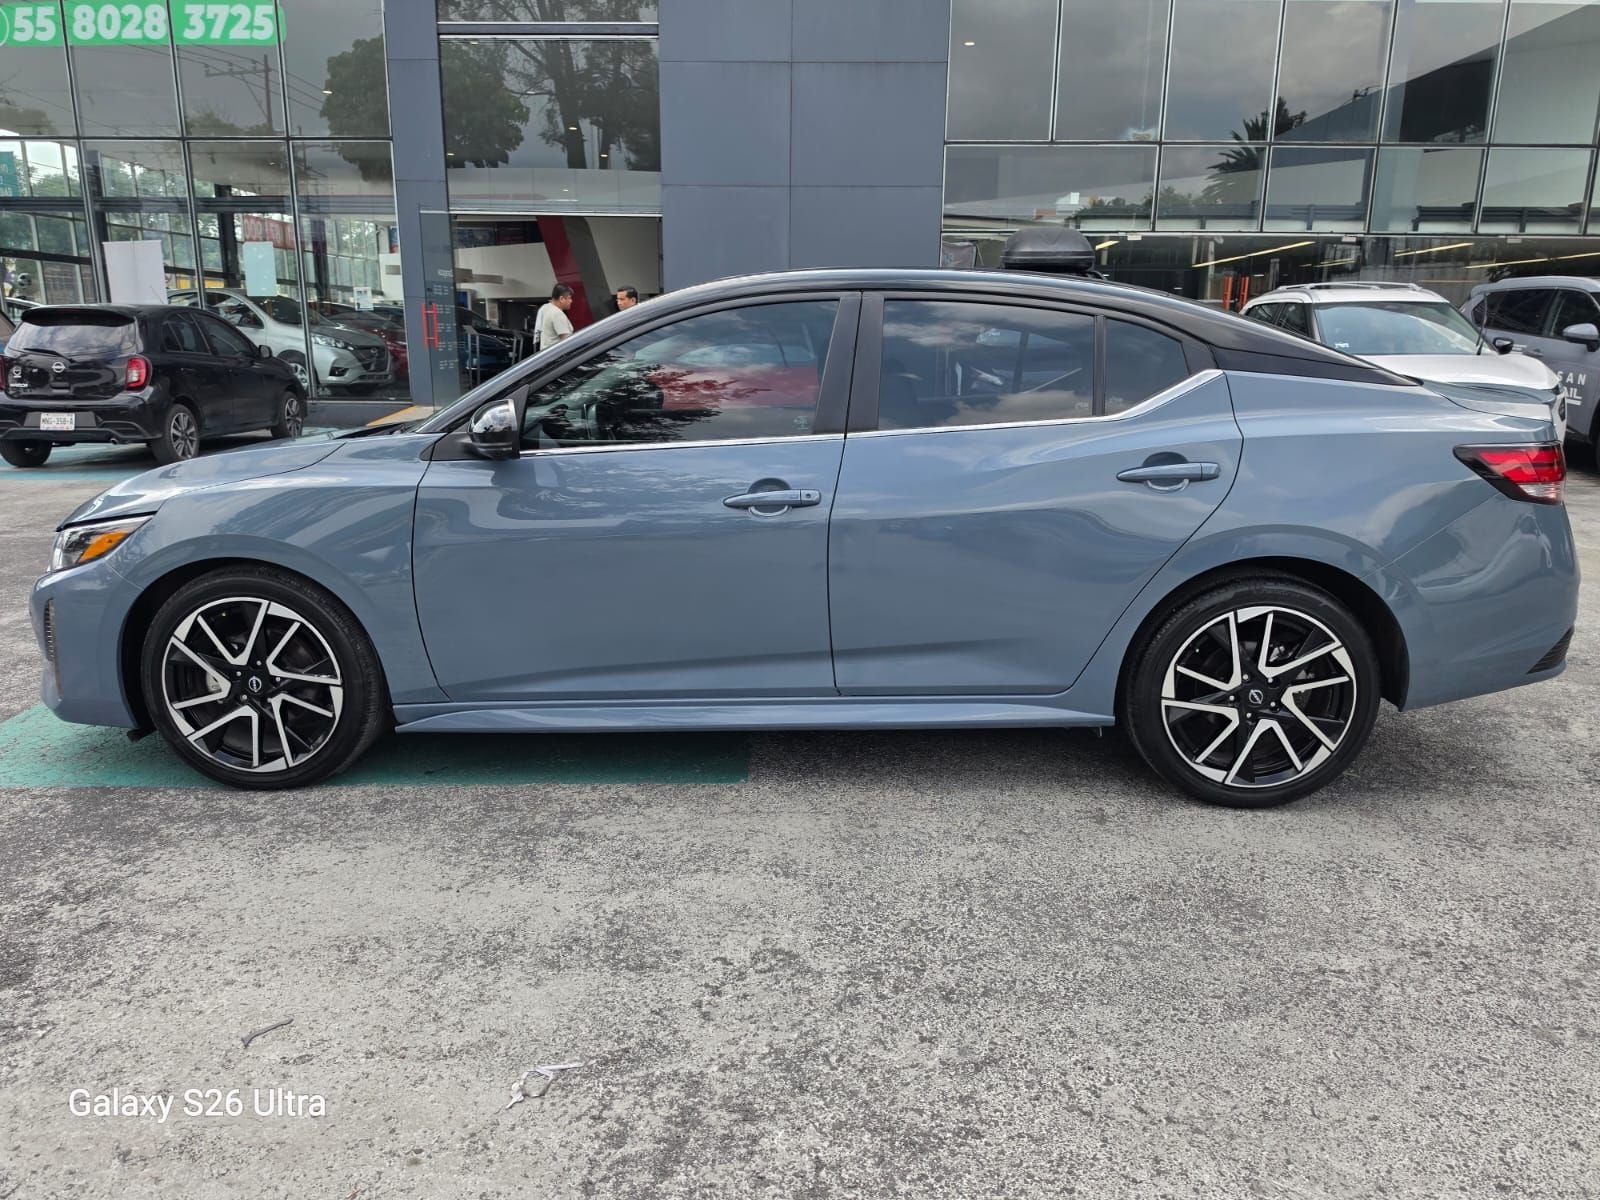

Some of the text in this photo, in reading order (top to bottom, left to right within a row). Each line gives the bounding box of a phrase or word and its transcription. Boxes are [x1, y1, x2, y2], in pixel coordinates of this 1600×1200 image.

[12, 5, 274, 41] 55 8028 3725
